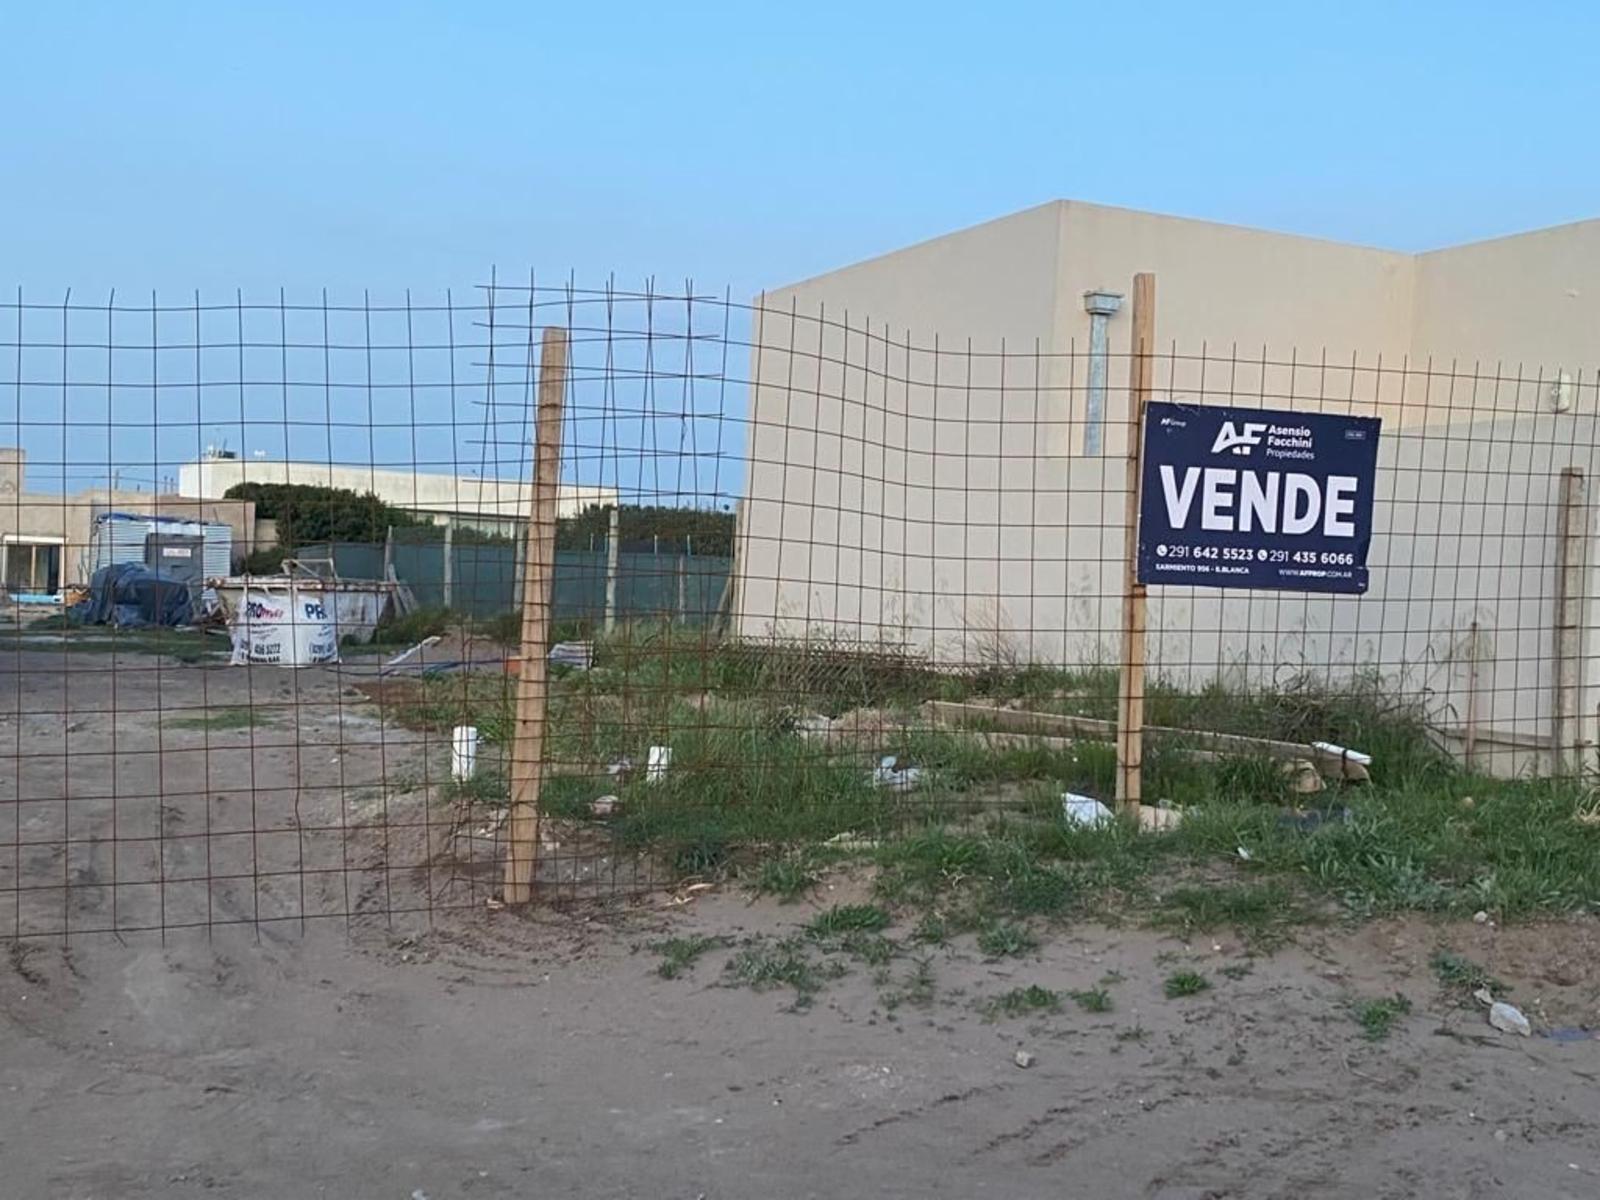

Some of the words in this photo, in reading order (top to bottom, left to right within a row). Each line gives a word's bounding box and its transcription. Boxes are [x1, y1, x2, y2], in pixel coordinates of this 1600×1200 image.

[1268, 425, 1311, 437] Asensio
[1210, 421, 1268, 455] AF
[1267, 436, 1312, 448] Facchini
[1266, 448, 1315, 460] Propiedades
[1159, 465, 1358, 538] VENDE
[1168, 545, 1189, 558] 291
[1193, 547, 1218, 559] 642
[1223, 548, 1254, 561] 5523
[1269, 550, 1289, 562] 291
[1293, 551, 1317, 563] 435
[1321, 553, 1354, 565] 6066
[1155, 563, 1196, 572] SARMIENTO
